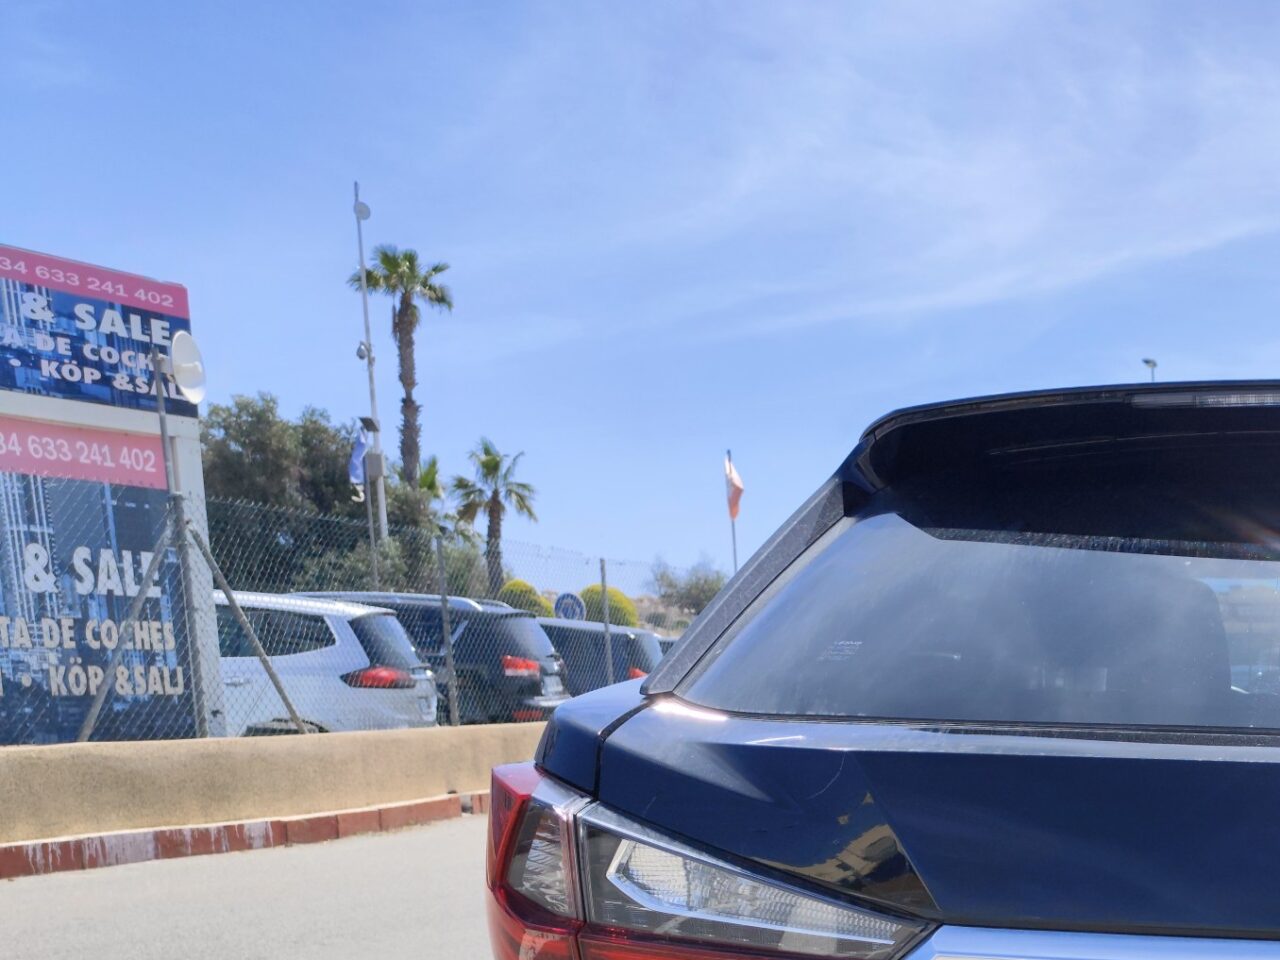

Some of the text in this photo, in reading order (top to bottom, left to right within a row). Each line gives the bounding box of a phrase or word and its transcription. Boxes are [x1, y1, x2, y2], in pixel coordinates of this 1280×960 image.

[0, 256, 174, 308] 34 633 241 402
[22, 292, 171, 346] & SALE
[36, 333, 72, 356] DE
[83, 343, 155, 371] COCH
[41, 358, 188, 401] KÖP &SAL
[28, 436, 72, 462] 633
[76, 441, 116, 468] 241
[120, 446, 156, 473] 402
[24, 543, 58, 593] &
[41, 618, 76, 649] DE
[50, 657, 104, 696] KÖP
